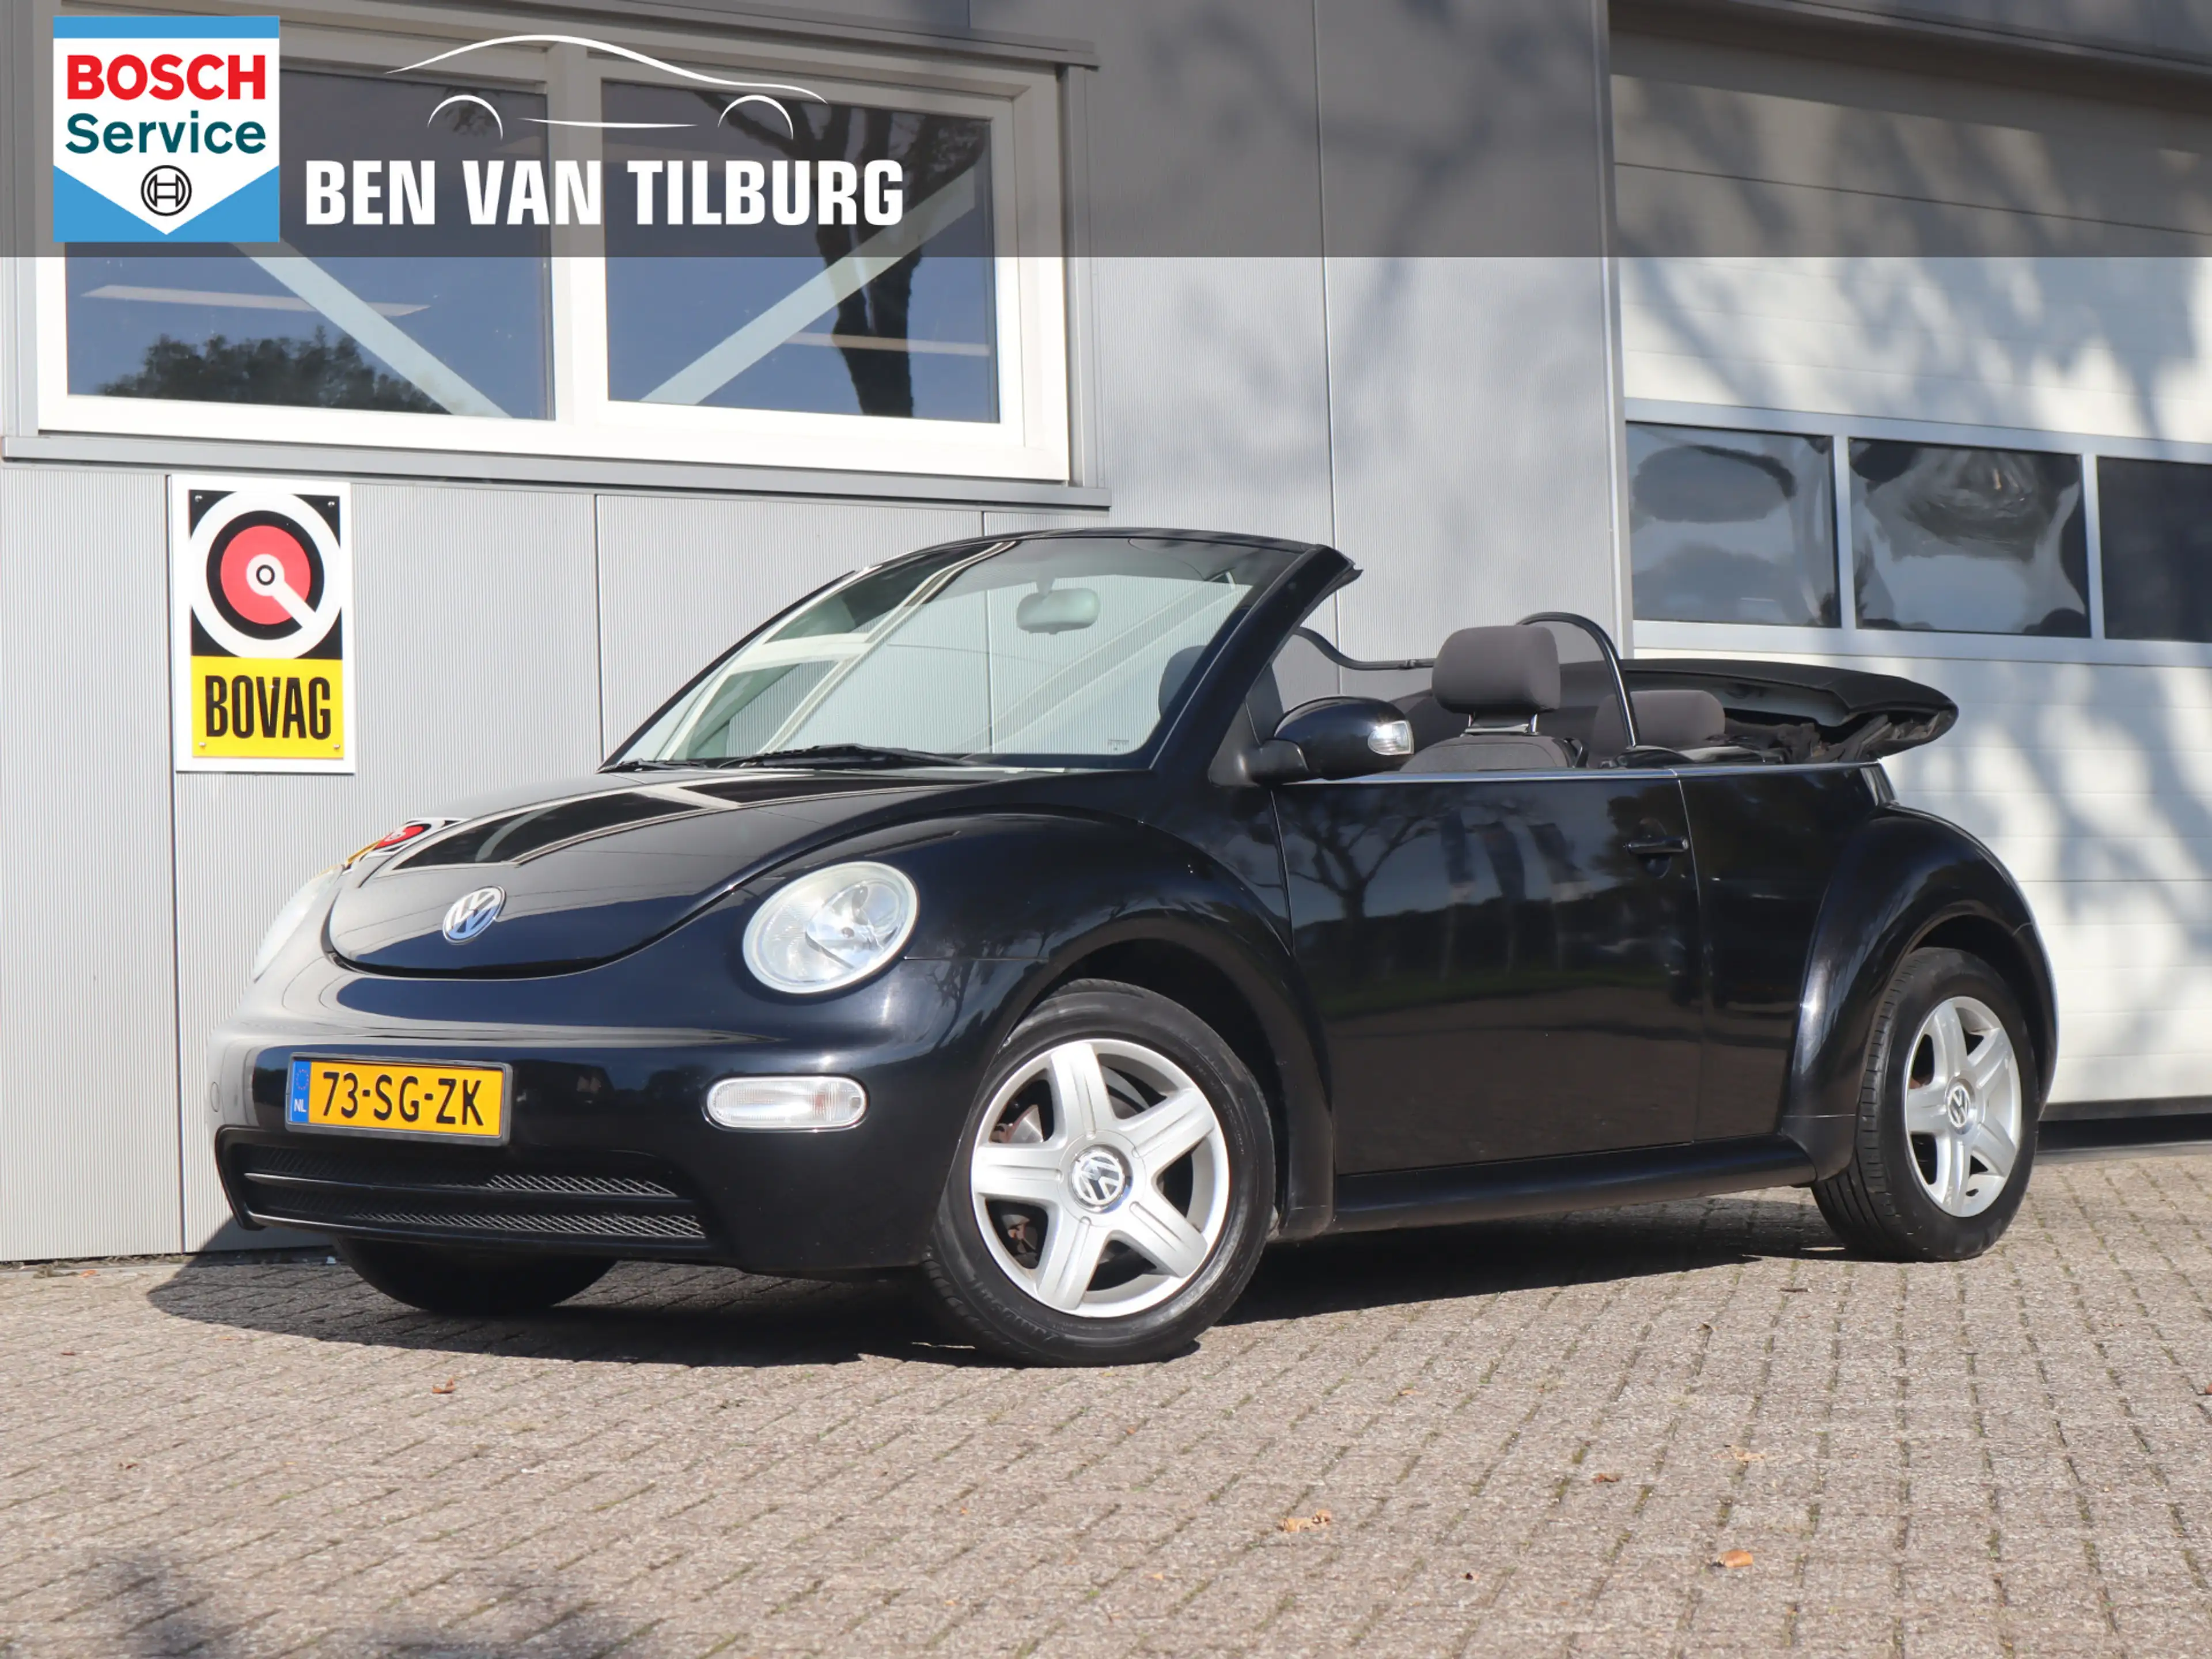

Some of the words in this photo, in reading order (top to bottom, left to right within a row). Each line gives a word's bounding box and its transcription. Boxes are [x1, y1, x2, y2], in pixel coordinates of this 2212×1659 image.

[205, 675, 332, 740] BOVAG
[294, 1098, 307, 1113] NL
[323, 1071, 484, 1126] 73-SG-ZK
